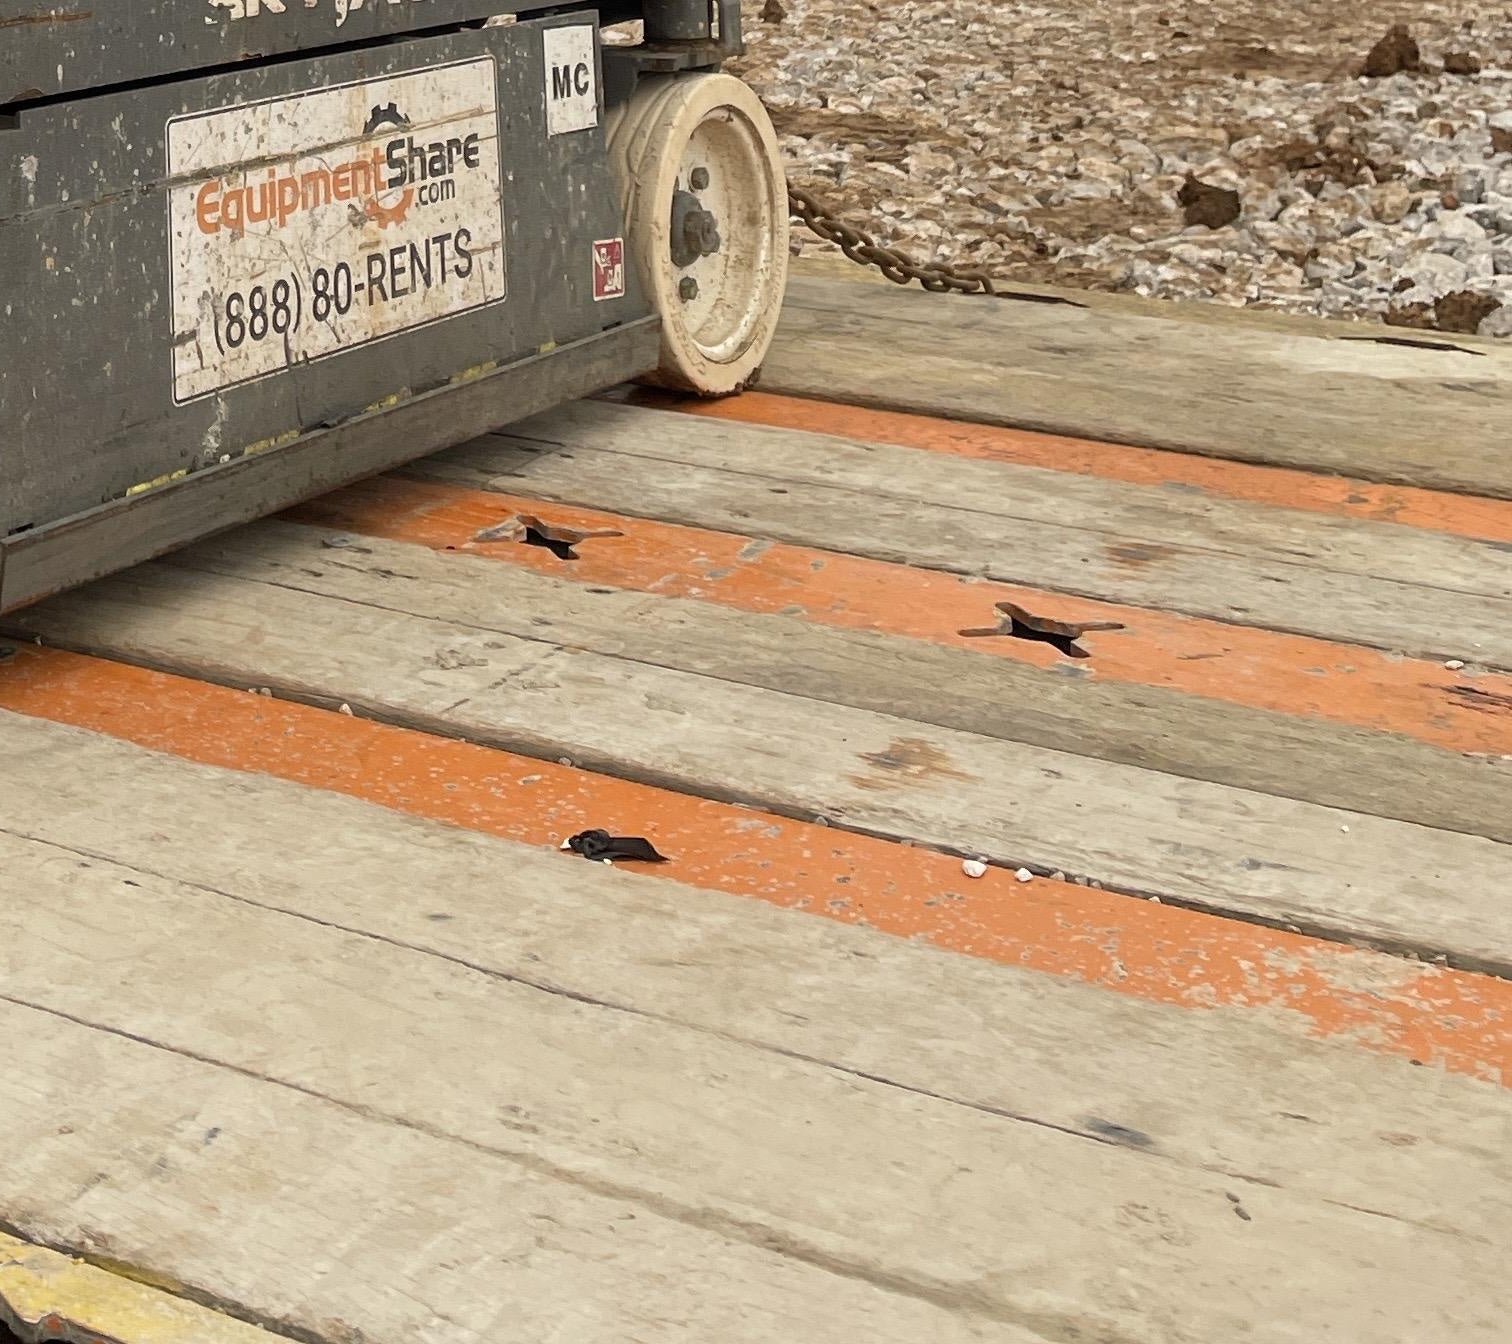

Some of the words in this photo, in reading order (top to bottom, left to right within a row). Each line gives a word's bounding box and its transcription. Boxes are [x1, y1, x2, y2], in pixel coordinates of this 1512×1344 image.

[552, 62, 590, 100] MC
[415, 178, 456, 208] .com
[213, 271, 302, 356] (888)
[312, 227, 474, 322] 80-RENTS
